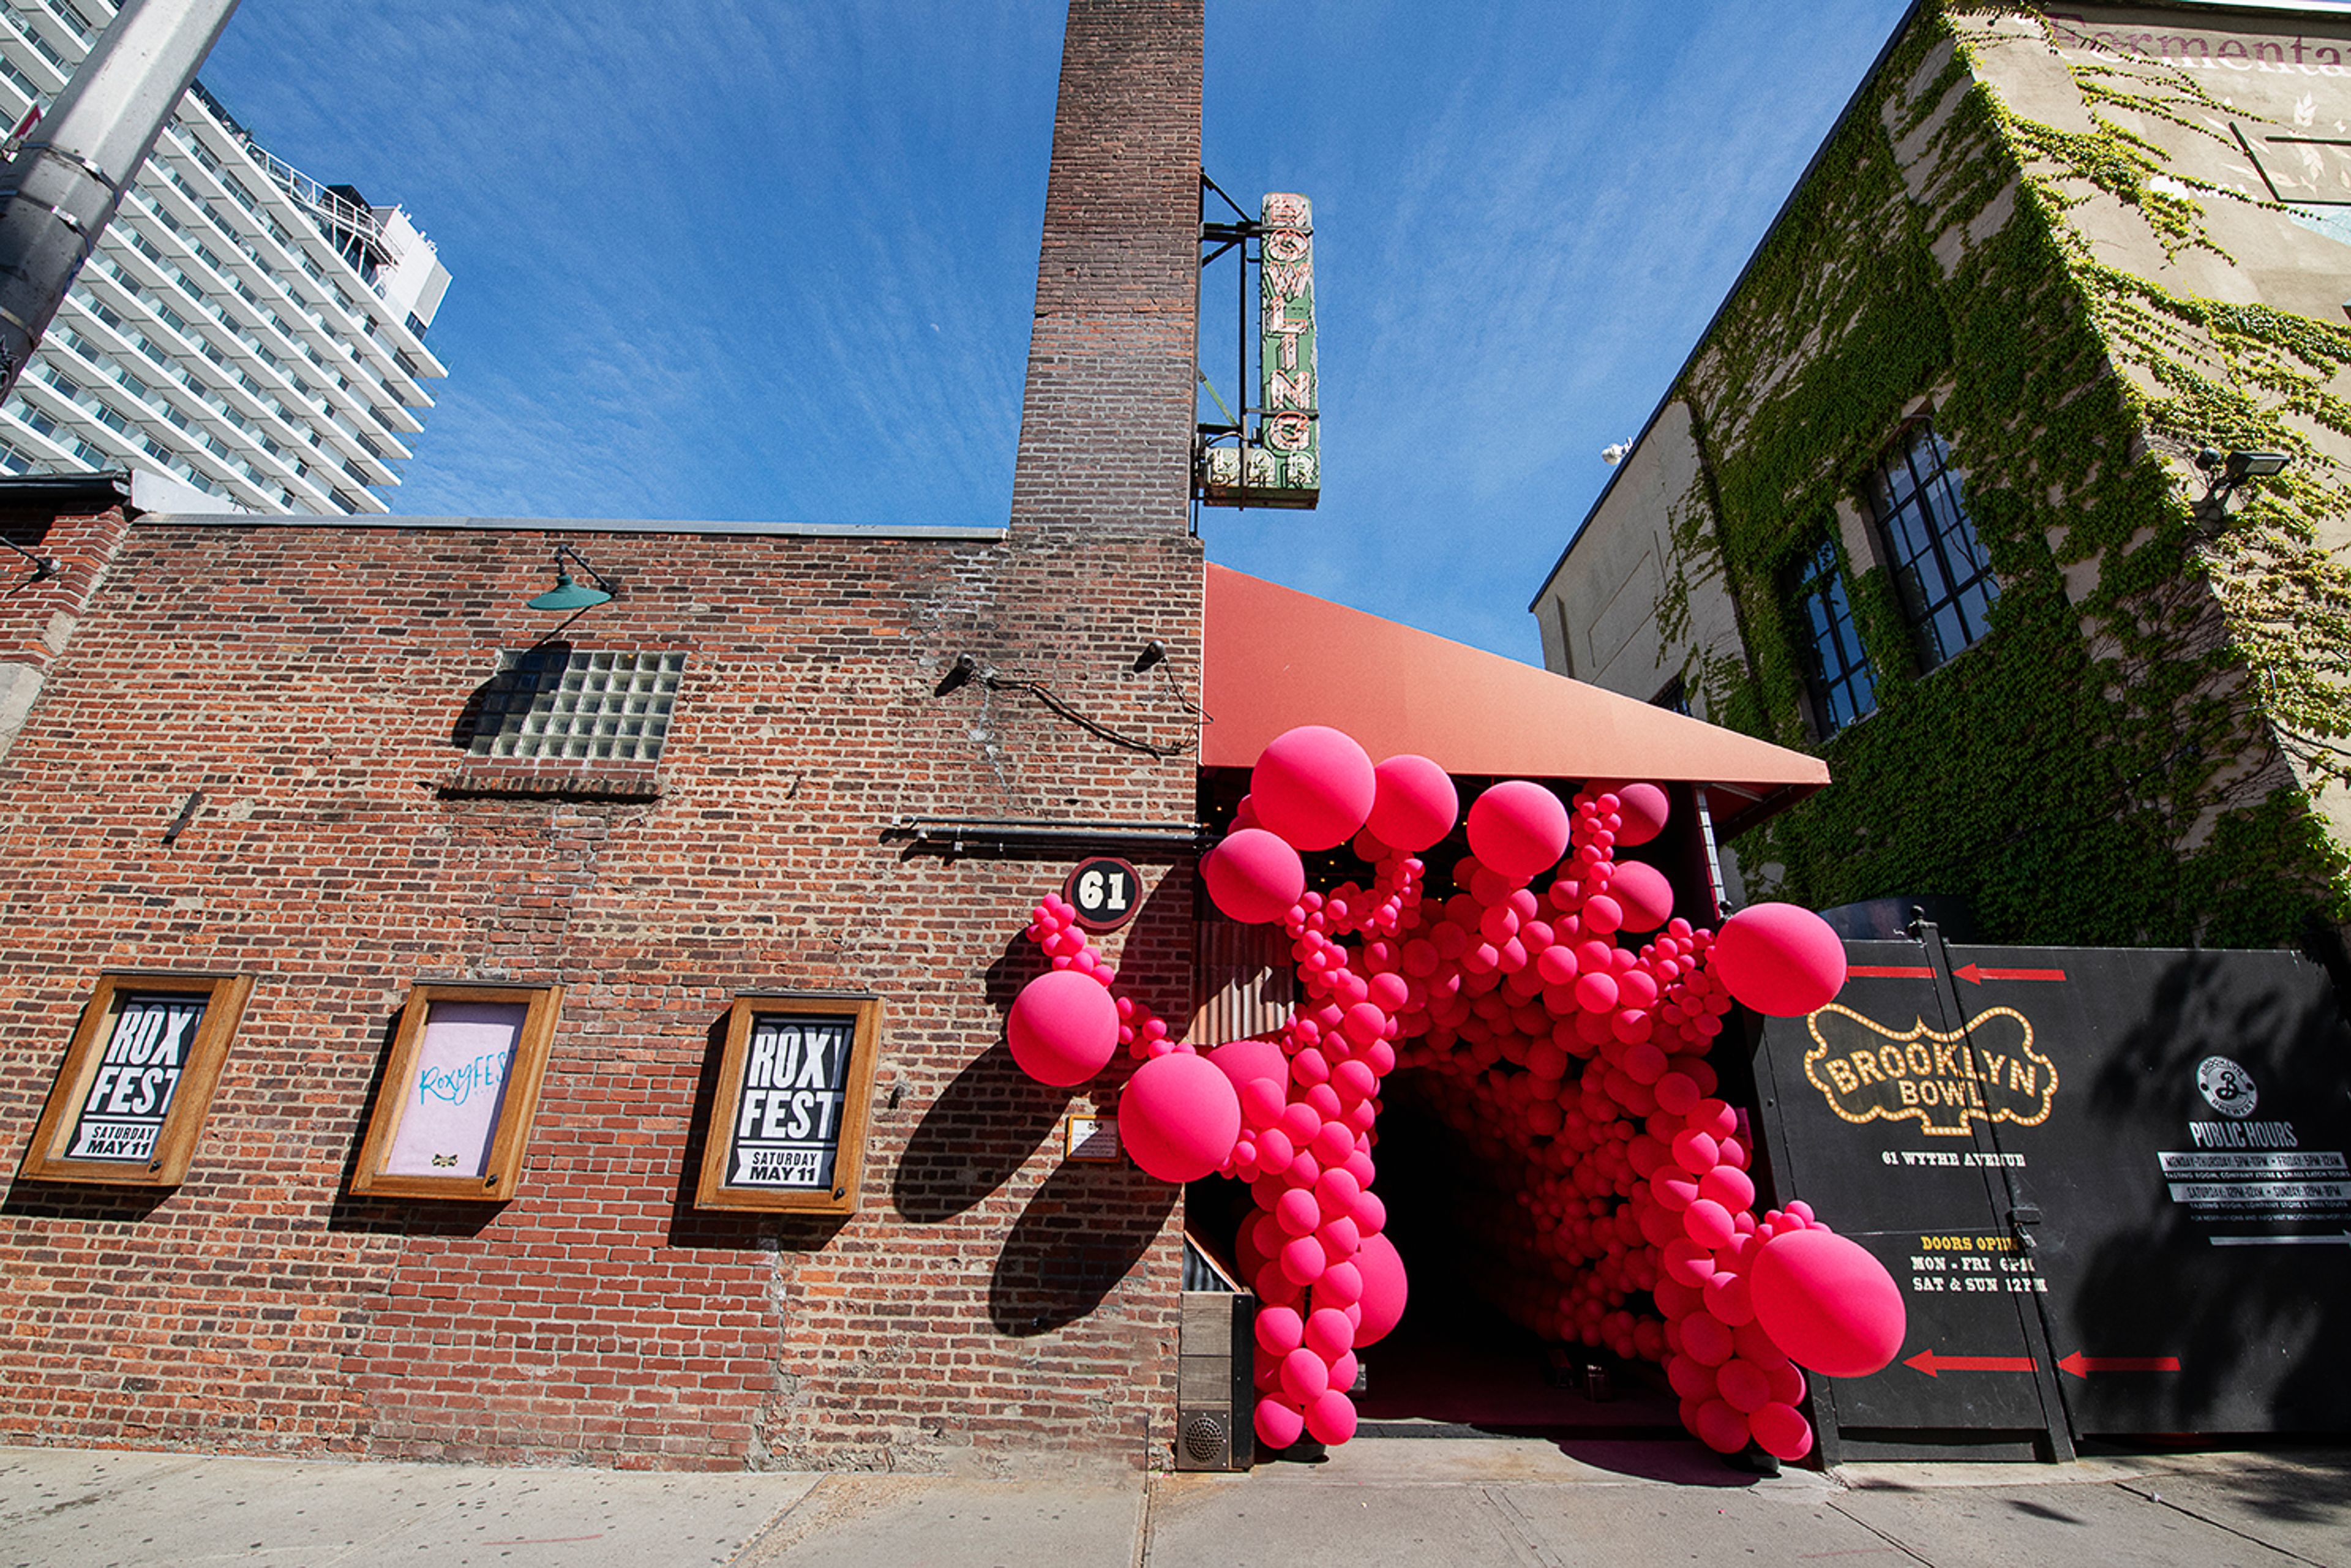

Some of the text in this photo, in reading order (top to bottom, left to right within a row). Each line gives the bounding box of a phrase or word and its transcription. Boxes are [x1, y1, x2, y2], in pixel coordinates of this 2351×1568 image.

[2042, 12, 2351, 77] Fermenta
[1267, 193, 1311, 451] BOWLING
[1212, 448, 1315, 484] BAR
[1079, 870, 1125, 910] 61
[748, 1026, 853, 1089] ROXY
[1825, 1042, 2036, 1098] BROOKLYN
[1898, 1080, 1987, 1107] BOWL
[738, 1090, 844, 1139] FEST
[92, 1126, 155, 1139] SATURDAY
[2188, 1122, 2298, 1148] PUBLIC HOURS
[86, 1140, 151, 1155] MAY 11
[753, 1151, 818, 1166] SATURDAY
[1881, 1151, 2026, 1167] 61 WYTHE AVENUE
[749, 1166, 816, 1182] MAY 11
[1921, 1236, 1973, 1251] DOORS
[1911, 1256, 1946, 1271] MON
[1961, 1257, 1992, 1272] FRI
[1913, 1277, 2048, 1292] SAT & SUN 12PM
